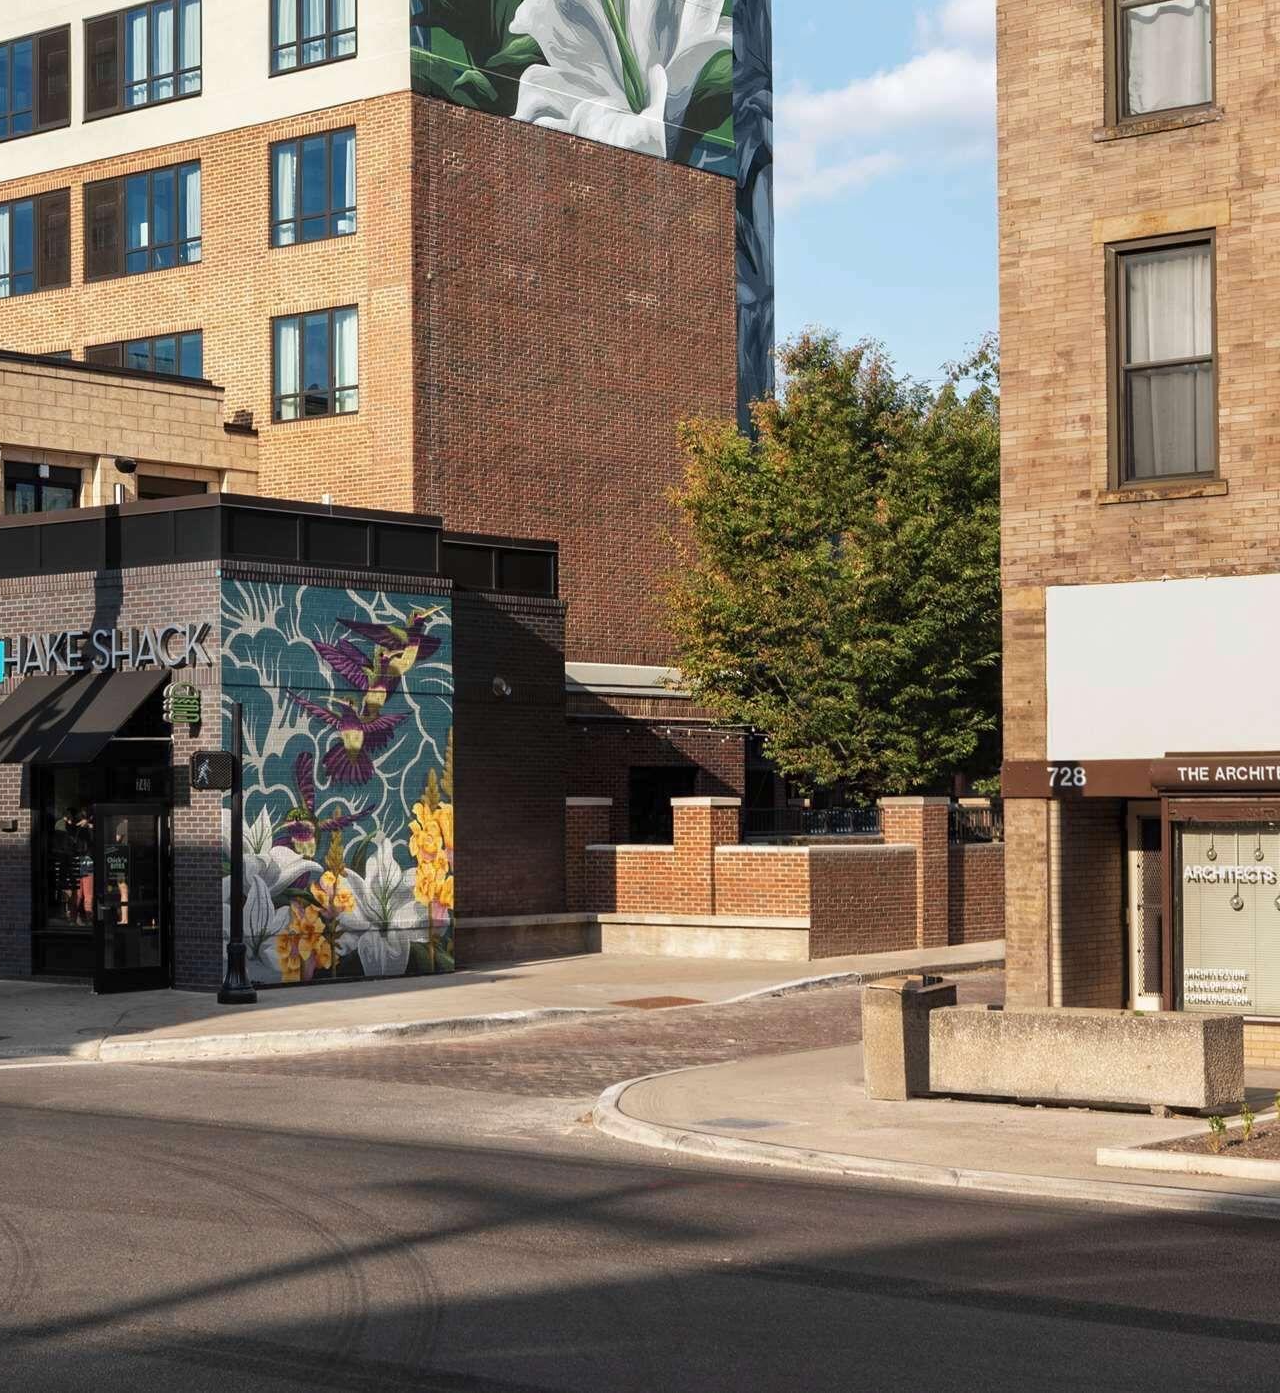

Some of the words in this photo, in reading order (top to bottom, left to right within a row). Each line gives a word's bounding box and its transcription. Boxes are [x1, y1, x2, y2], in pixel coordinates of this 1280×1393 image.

[4, 631, 85, 674] HAKE
[92, 623, 212, 671] SHACK
[1047, 766, 1088, 787] 728
[1177, 766, 1209, 781] THE
[1214, 765, 1280, 782] ARCHIT
[1183, 864, 1274, 881] ARCHITECTS
[1184, 968, 1248, 977] ARCHITECTURE
